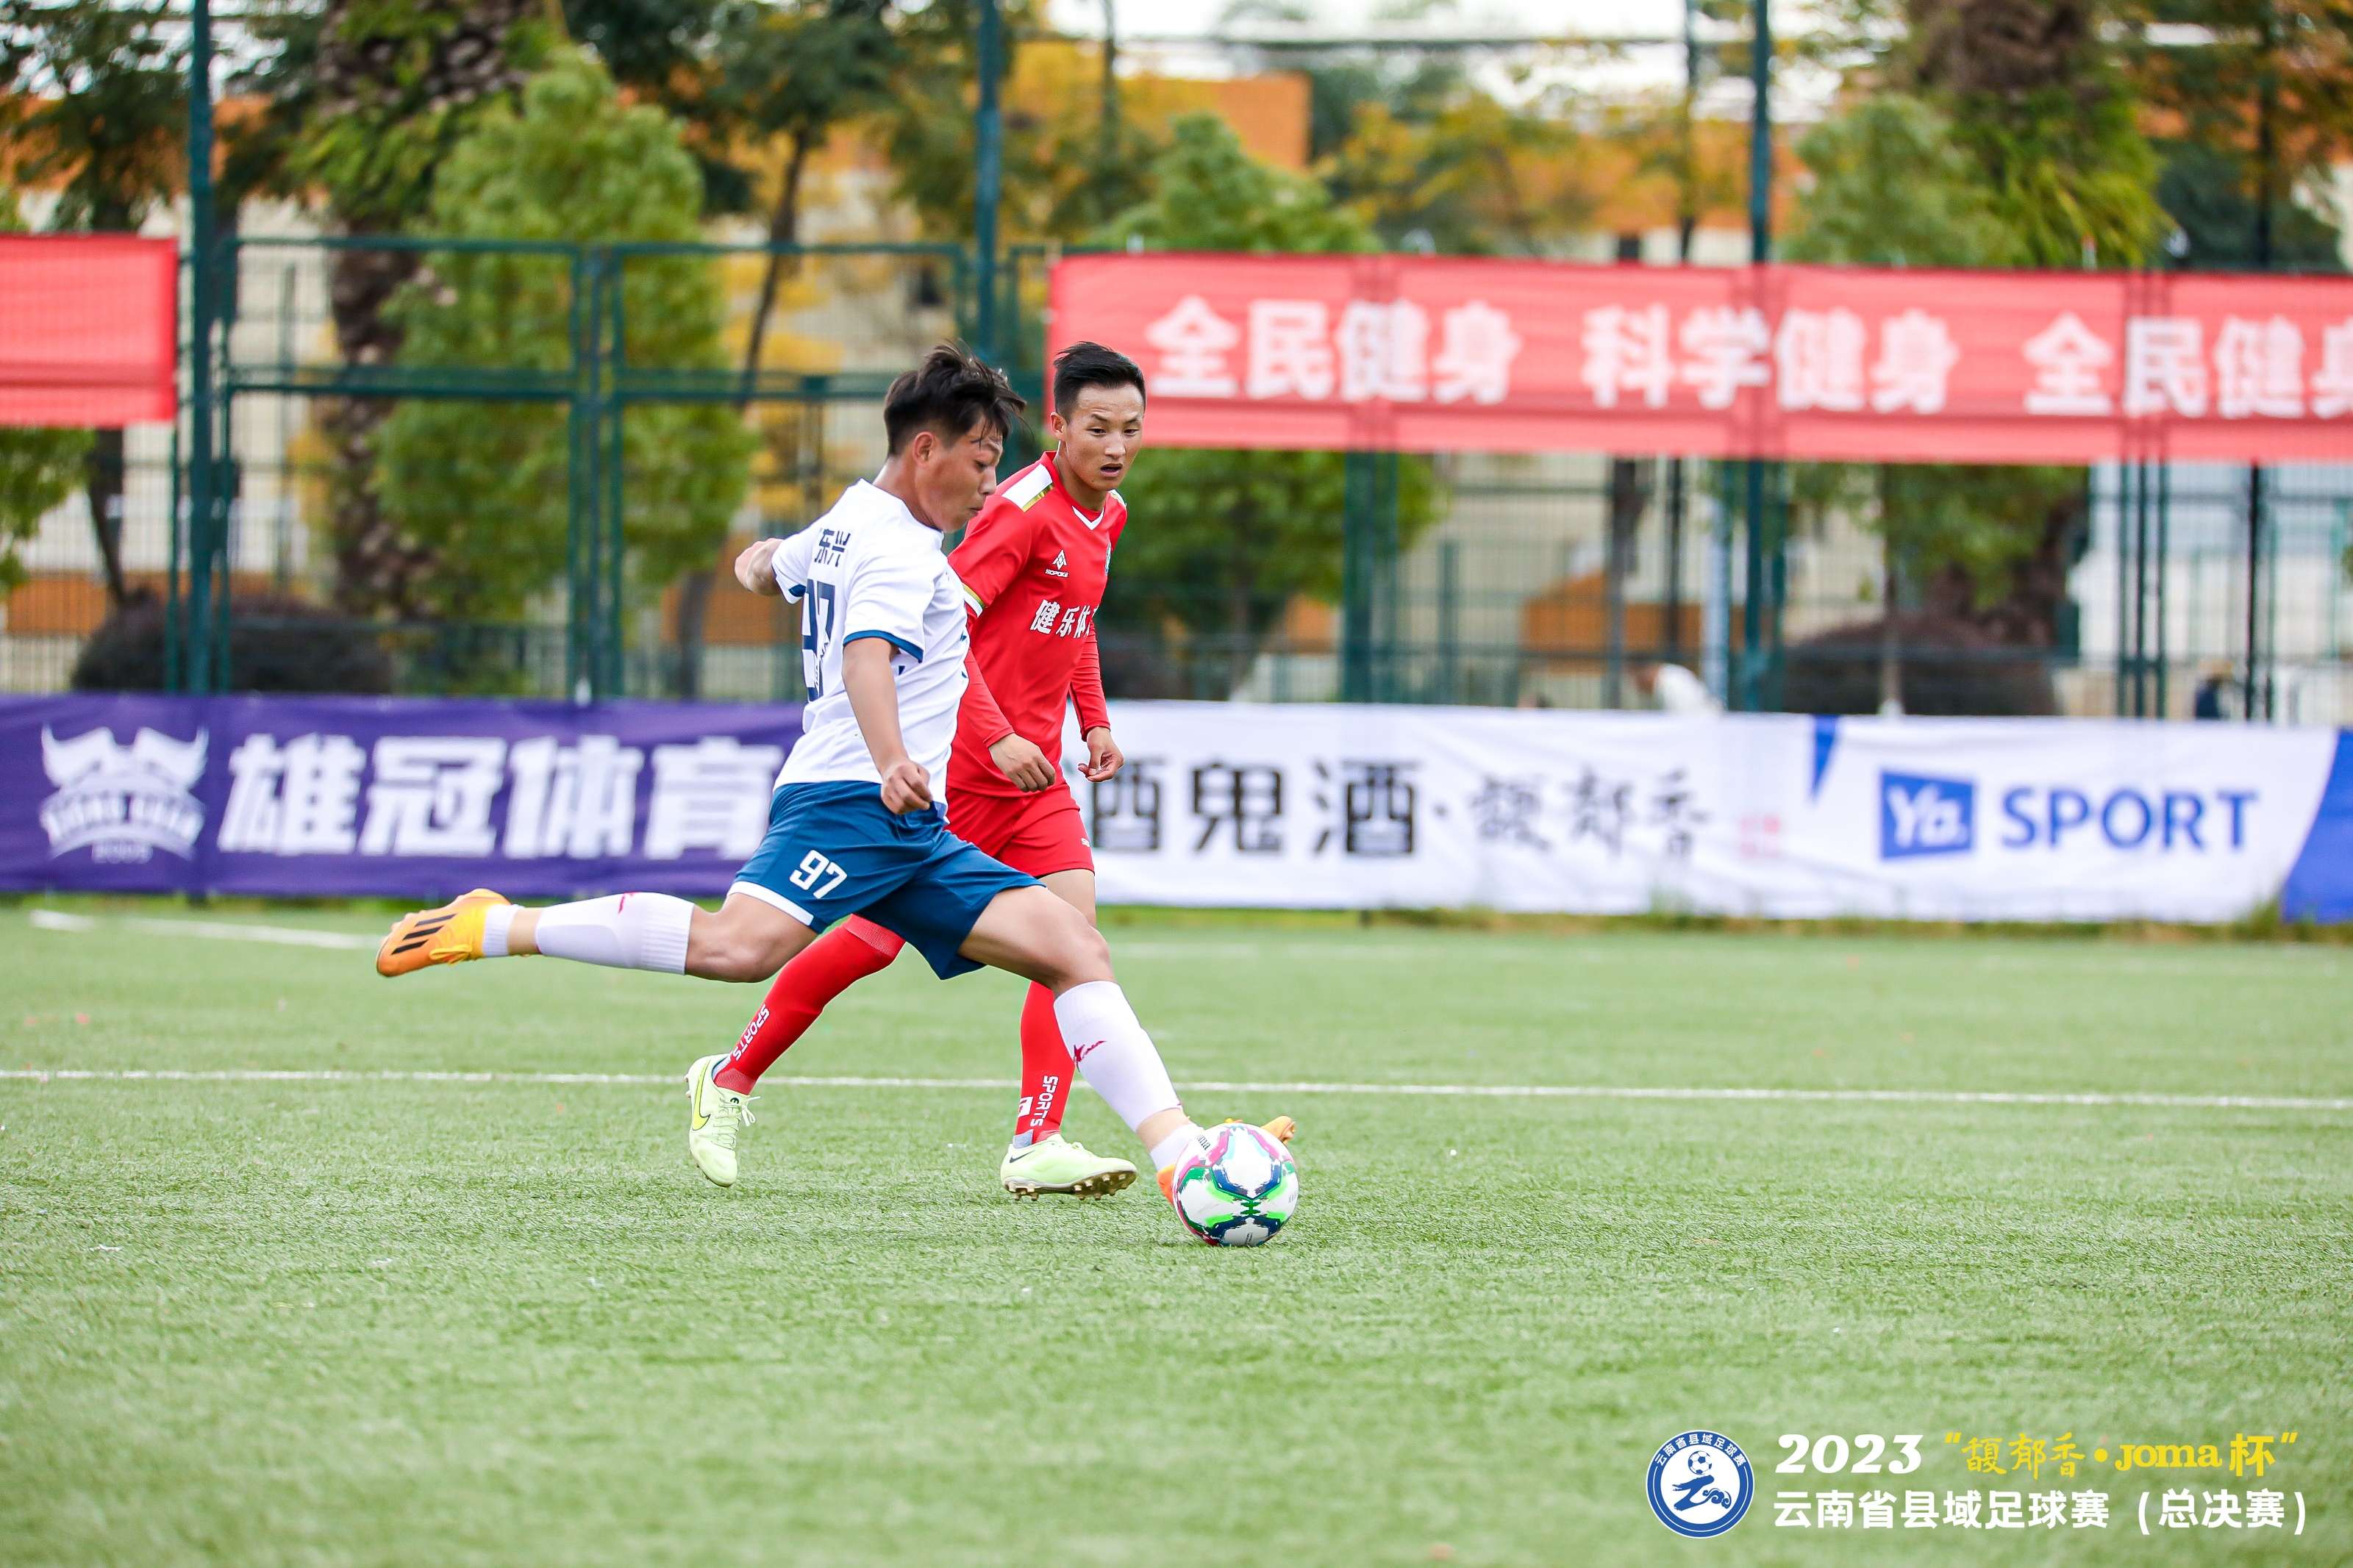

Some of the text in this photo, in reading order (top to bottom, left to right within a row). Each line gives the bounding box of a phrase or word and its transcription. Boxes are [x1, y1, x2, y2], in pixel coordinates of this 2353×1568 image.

[1146, 296, 1521, 406] 全民健身
[1581, 301, 1959, 415] 科学健身
[1030, 599, 1099, 639] 健乐体
[218, 731, 784, 860] 雄冠体育
[2002, 787, 2257, 851] SPORT
[790, 849, 848, 899] 97
[732, 1003, 770, 1062] SPORTS
[1029, 1075, 1059, 1127] SPORTS
